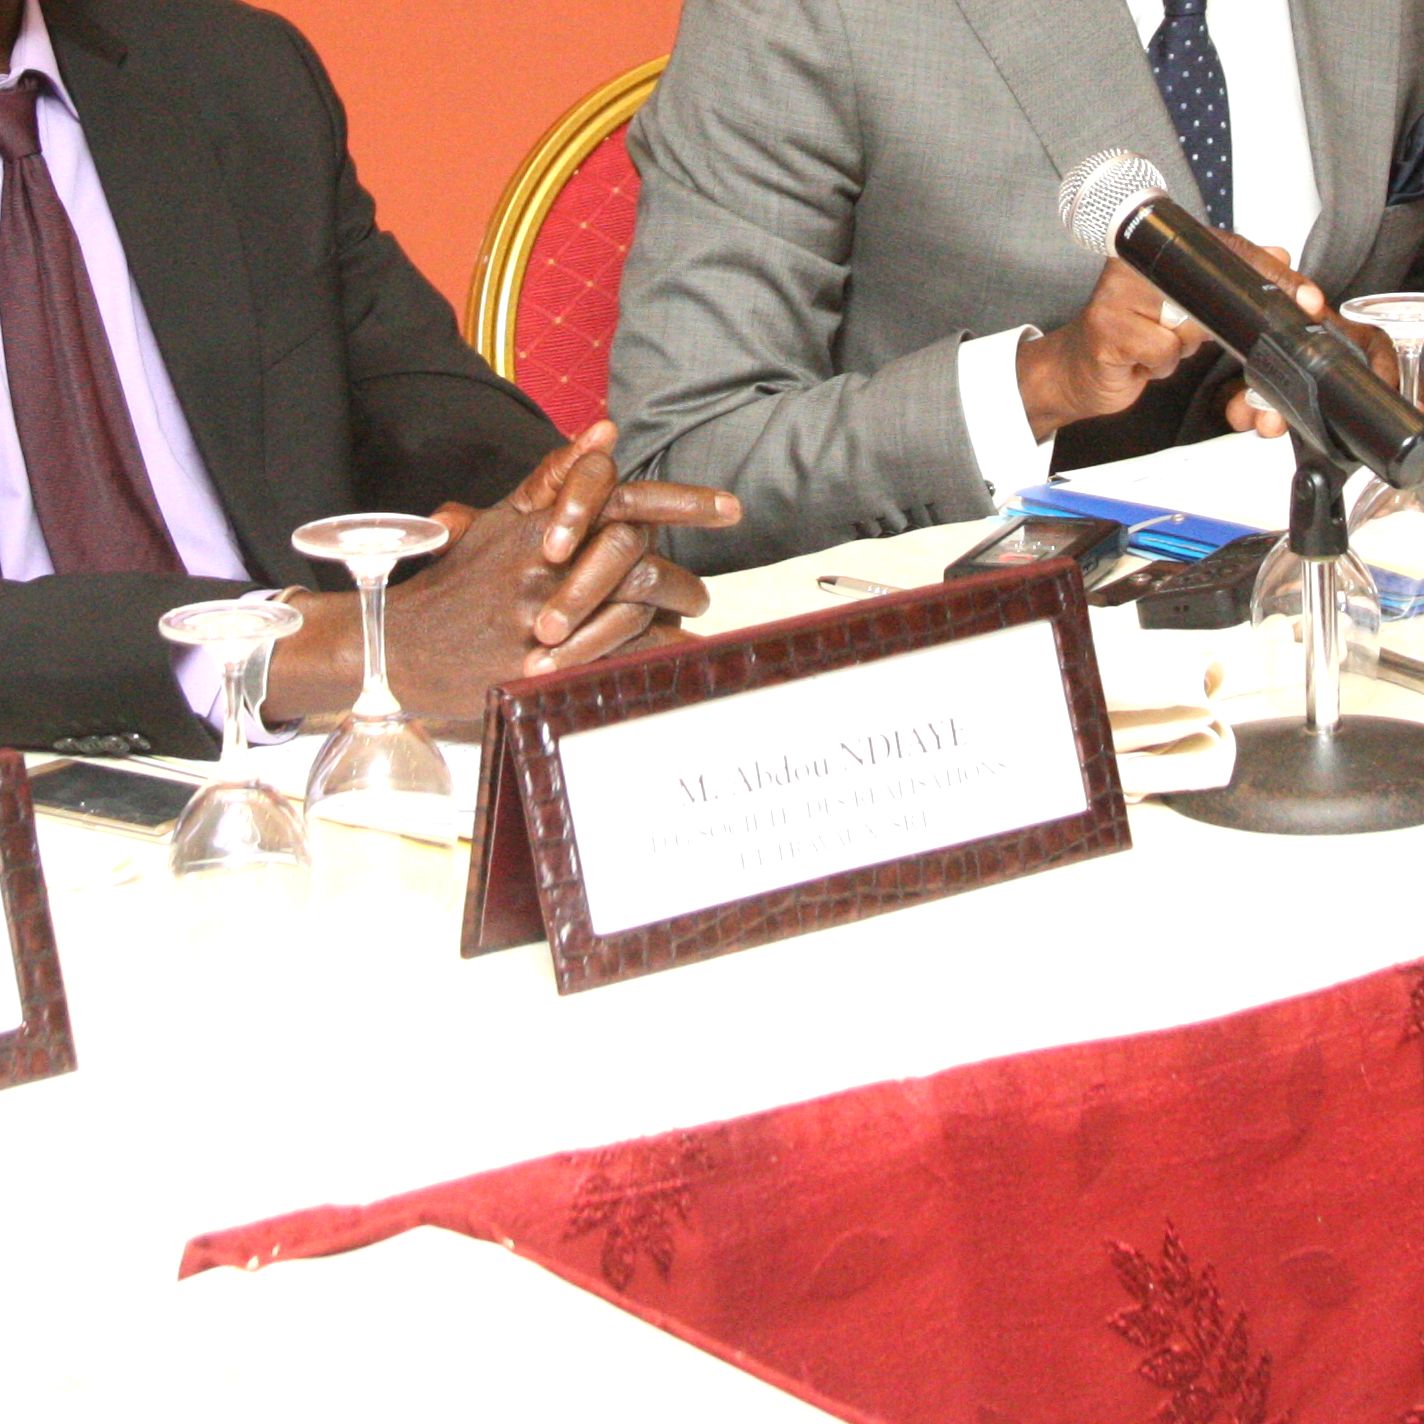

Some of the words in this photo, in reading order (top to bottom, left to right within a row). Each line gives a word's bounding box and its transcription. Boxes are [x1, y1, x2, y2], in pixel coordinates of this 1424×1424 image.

[677, 773, 719, 807] M.
[731, 753, 832, 797] Abdou
[838, 716, 967, 771] NDIAYE
